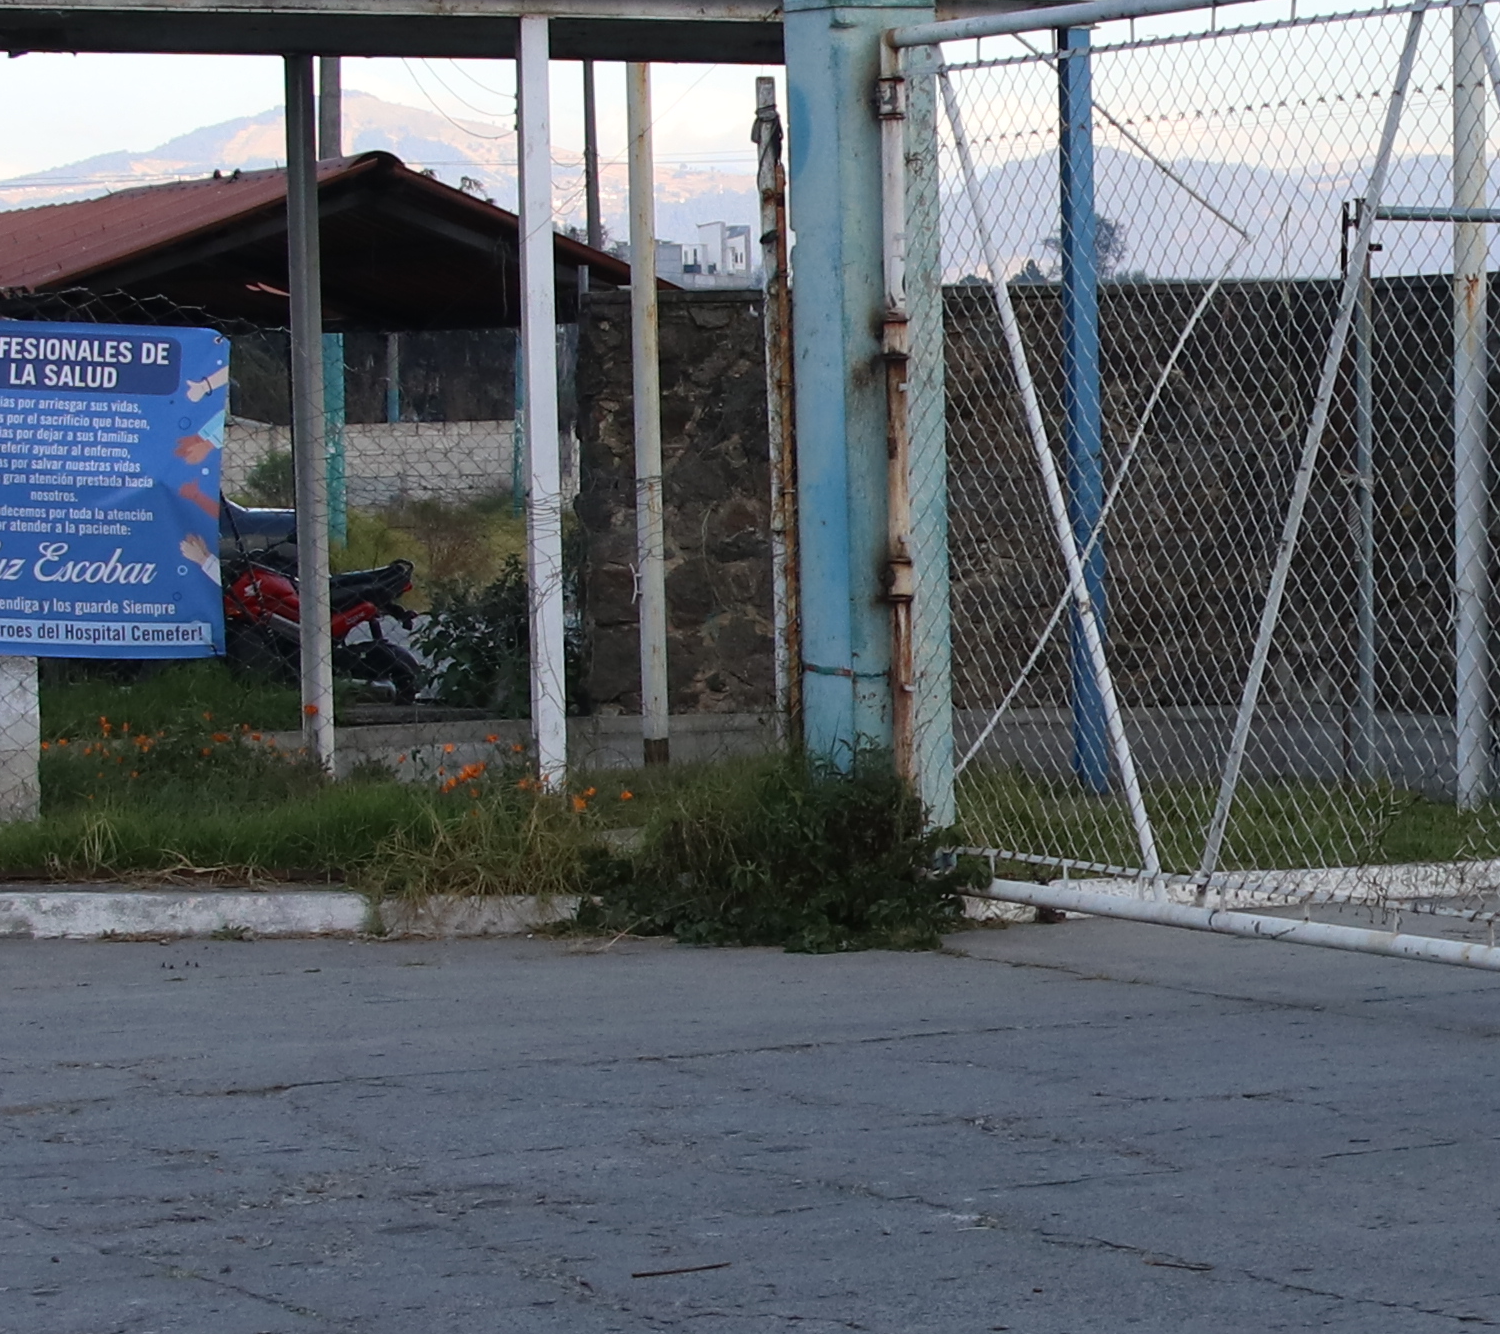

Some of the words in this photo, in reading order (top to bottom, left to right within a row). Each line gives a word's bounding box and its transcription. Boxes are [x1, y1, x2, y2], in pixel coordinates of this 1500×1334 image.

[142, 343, 169, 364] DE
[10, 363, 36, 385] LA
[44, 365, 116, 387] SALUD
[18, 399, 35, 410] por
[38, 398, 87, 412] arriesgar
[90, 402, 108, 411] sus
[111, 400, 141, 413] vidas,
[7, 414, 24, 426] por
[28, 413, 37, 424] el
[40, 414, 90, 426] sacrificio
[93, 418, 112, 429] que
[115, 416, 150, 430] hacen,
[3, 474, 26, 485] gran
[29, 473, 73, 485] atención
[76, 475, 122, 487] prestada
[31, 490, 78, 502] nosotros.
[49, 509, 67, 520] por
[69, 508, 91, 519] toda
[95, 508, 104, 519] la
[107, 509, 153, 521] atención
[34, 542, 157, 584] Escobar
[43, 601, 49, 614] y
[53, 598, 71, 612] los
[75, 600, 118, 615] guarde
[123, 600, 175, 617] Siempre
[38, 623, 59, 639] del
[65, 624, 125, 644] Hospital
[131, 625, 203, 641] Cemefer!
